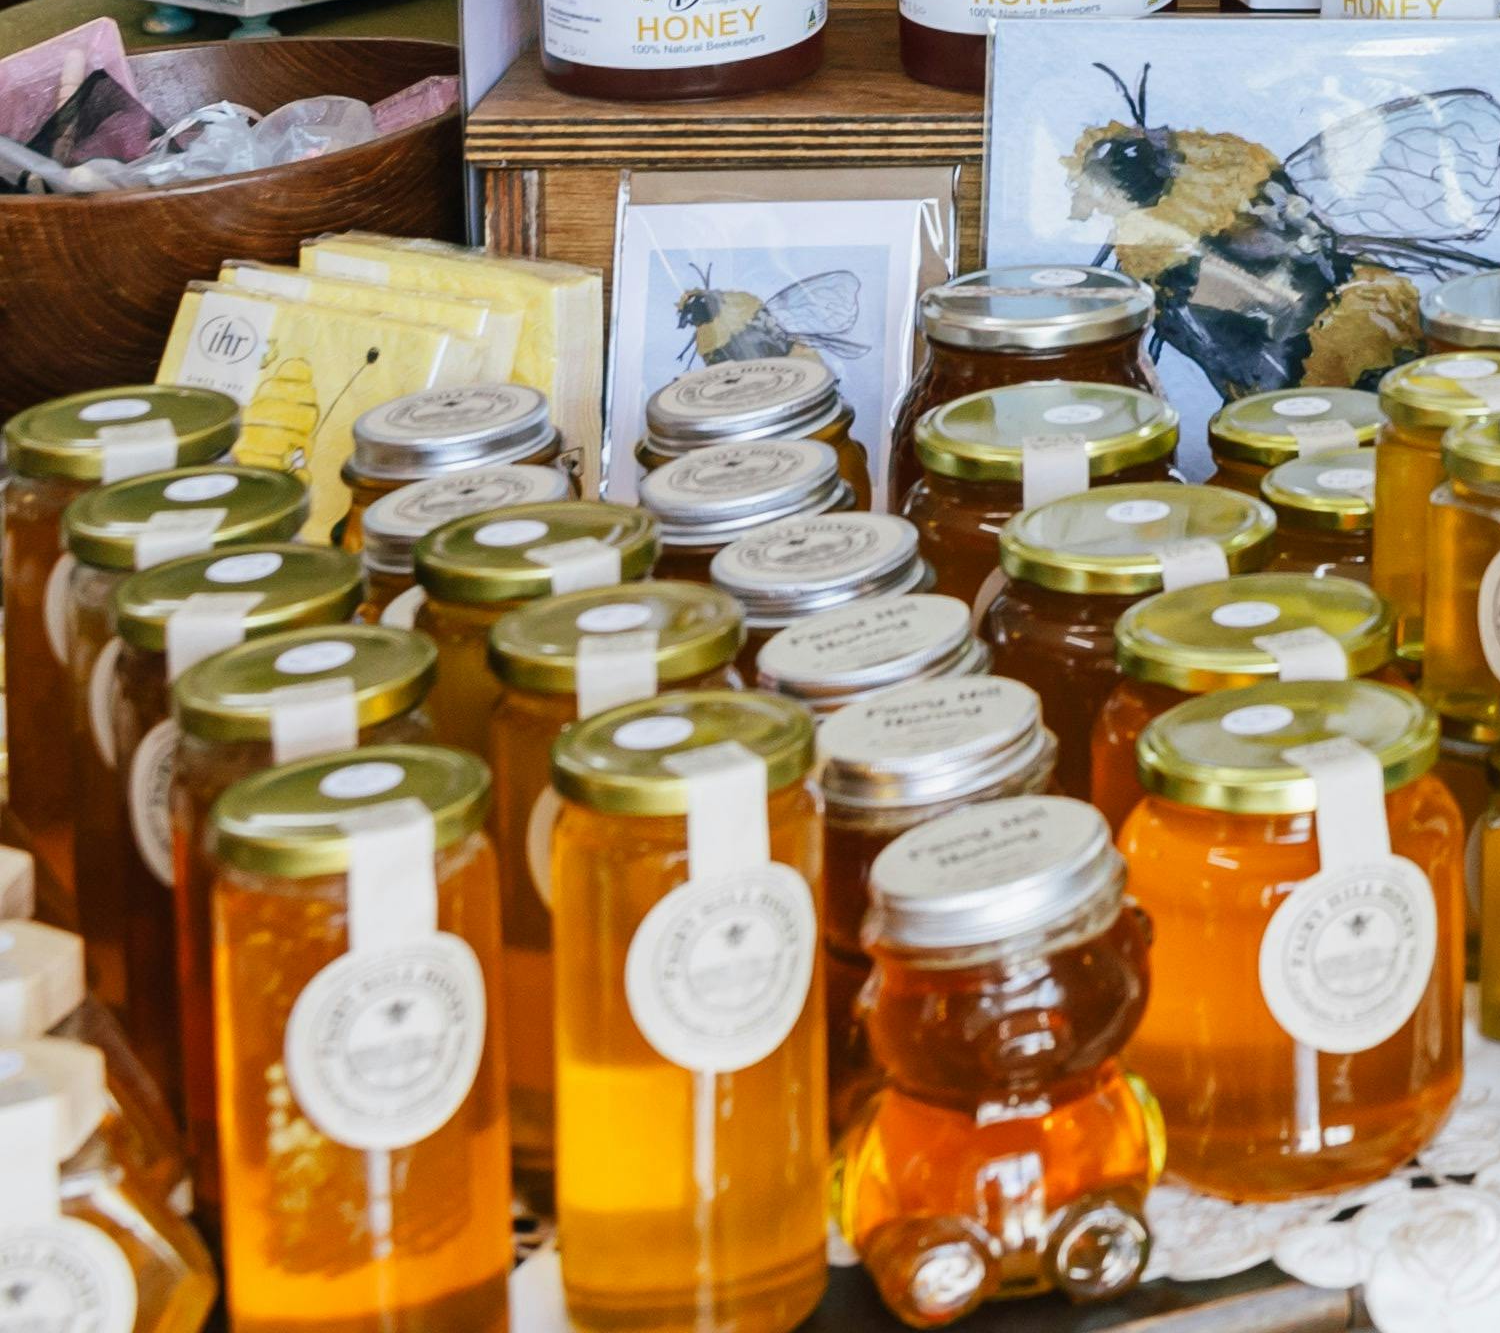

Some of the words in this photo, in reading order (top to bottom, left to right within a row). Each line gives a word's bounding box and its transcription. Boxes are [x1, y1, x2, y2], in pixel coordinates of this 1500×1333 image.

[637, 5, 761, 42] HONEY
[631, 44, 661, 55] 100%
[664, 42, 703, 55] Natural
[706, 34, 766, 52] Beekeepers
[207, 320, 249, 357] ihr
